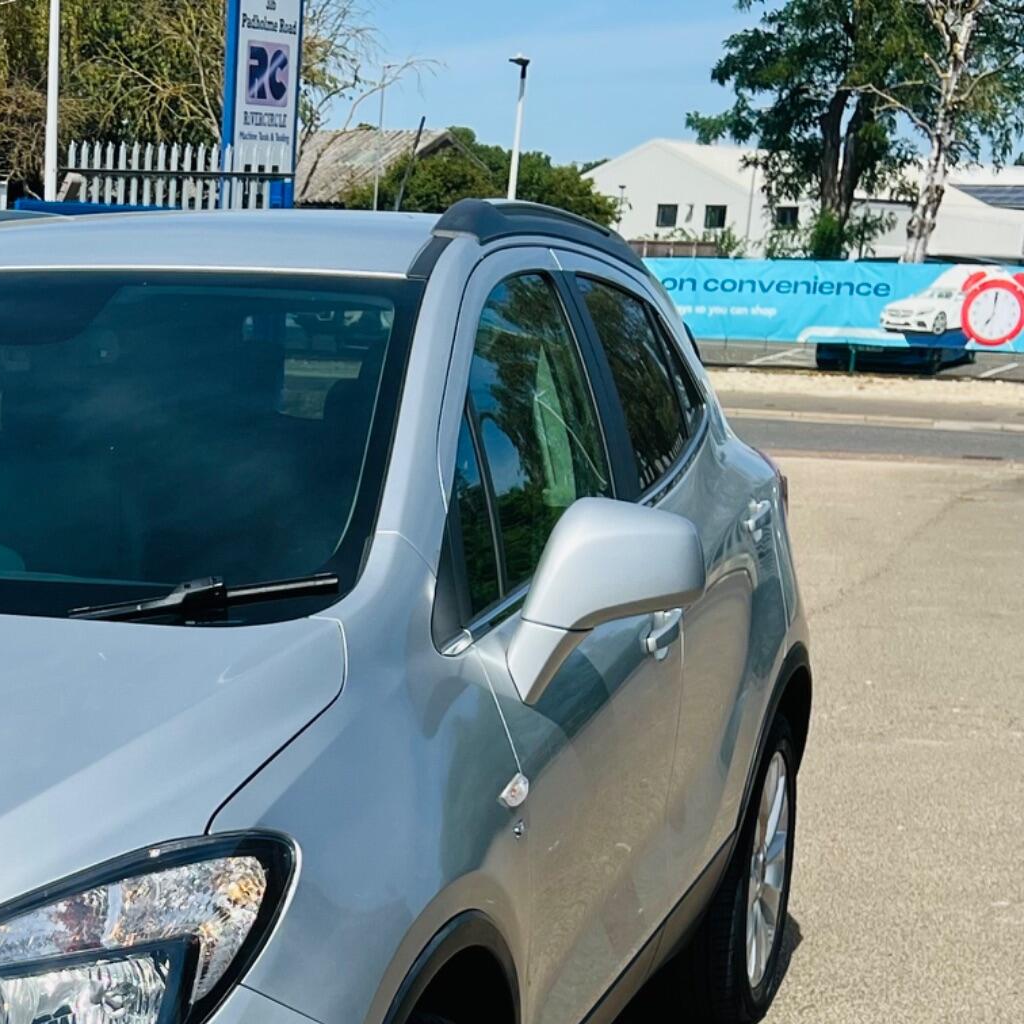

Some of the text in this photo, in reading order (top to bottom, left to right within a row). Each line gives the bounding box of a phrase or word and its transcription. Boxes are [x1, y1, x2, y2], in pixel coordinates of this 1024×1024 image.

[278, 18, 297, 35] Road
[662, 276, 891, 298] on convenience
